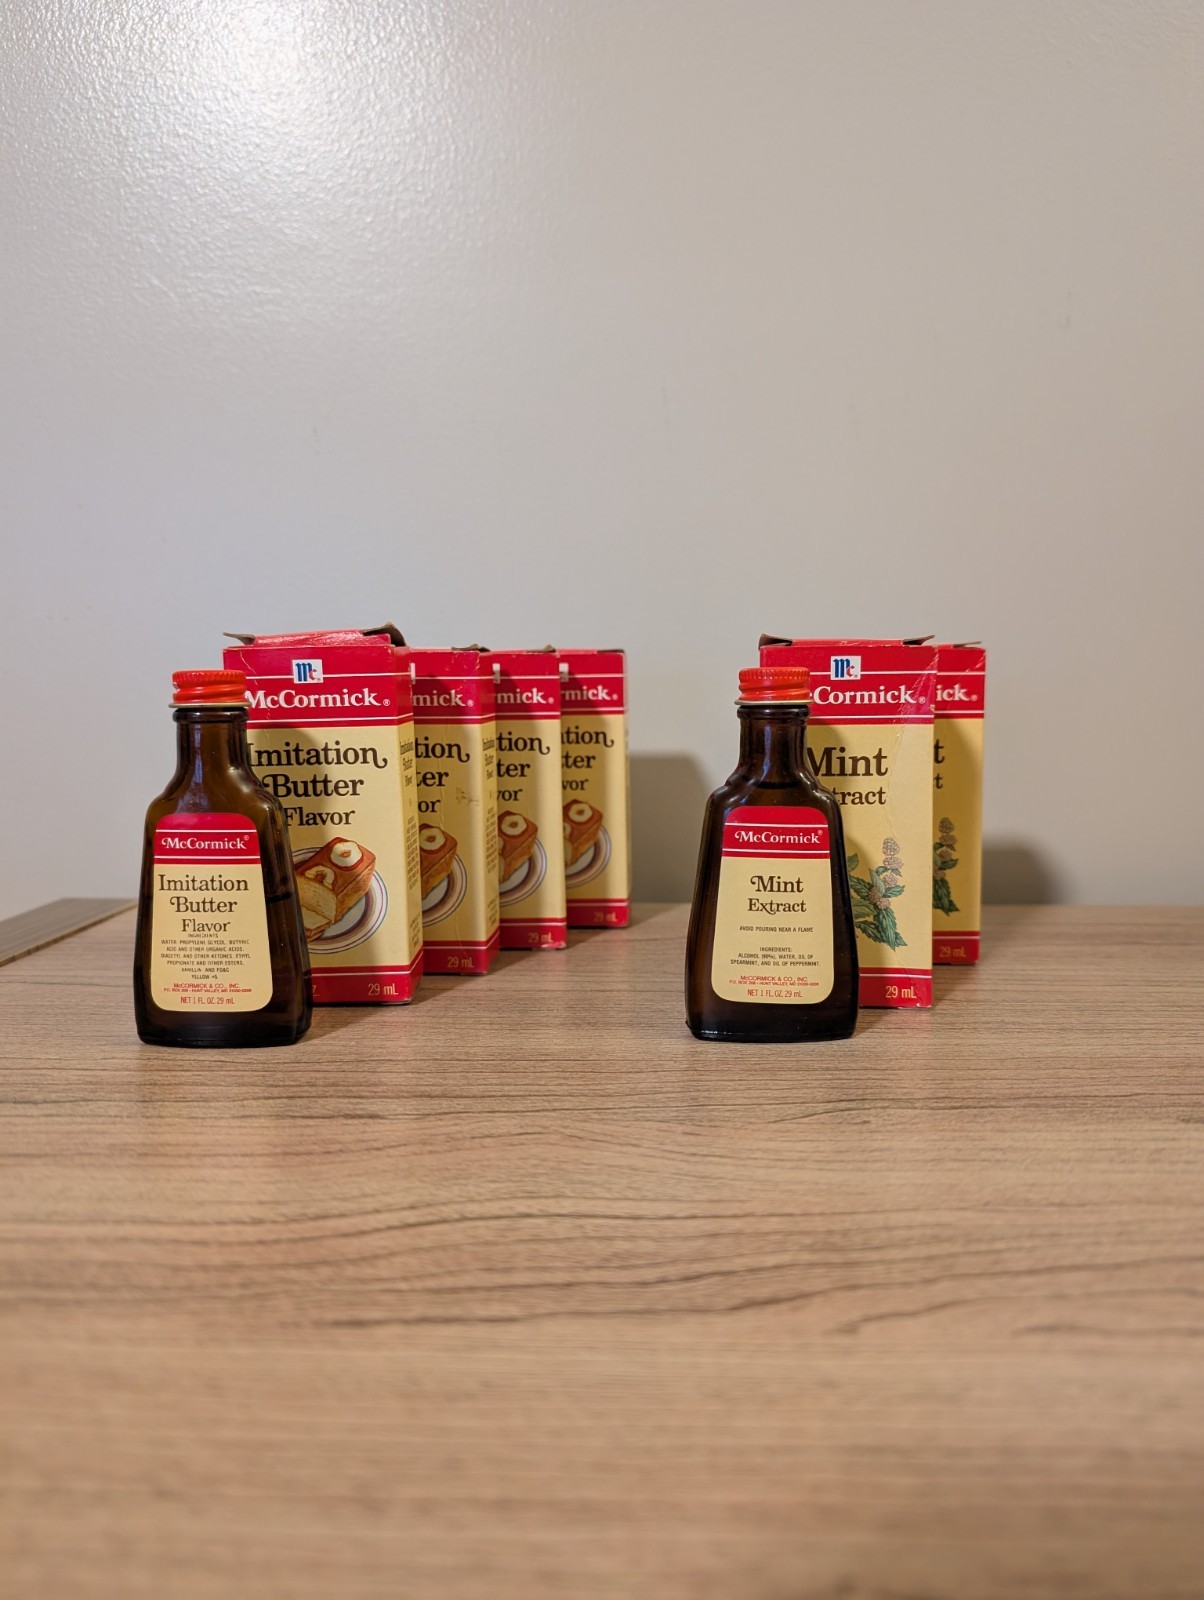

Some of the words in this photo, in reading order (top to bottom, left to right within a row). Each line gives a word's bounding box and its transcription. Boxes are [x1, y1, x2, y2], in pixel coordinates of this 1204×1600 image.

[806, 746, 889, 777] Mint
[262, 773, 364, 798] Butter
[158, 874, 249, 892] Imitation
[750, 876, 804, 893] Mint
[170, 896, 238, 913] Butter
[747, 898, 807, 915] Extract
[182, 919, 231, 932] Flavor
[528, 932, 539, 942] 29
[940, 946, 951, 957] 29
[447, 957, 459, 968] 29
[368, 983, 380, 996] 29
[384, 983, 398, 996] mL
[747, 988, 758, 996] NET
[784, 989, 793, 997] 29
[885, 985, 898, 998] 29
[902, 985, 917, 998] mL
[180, 996, 191, 1004] NET
